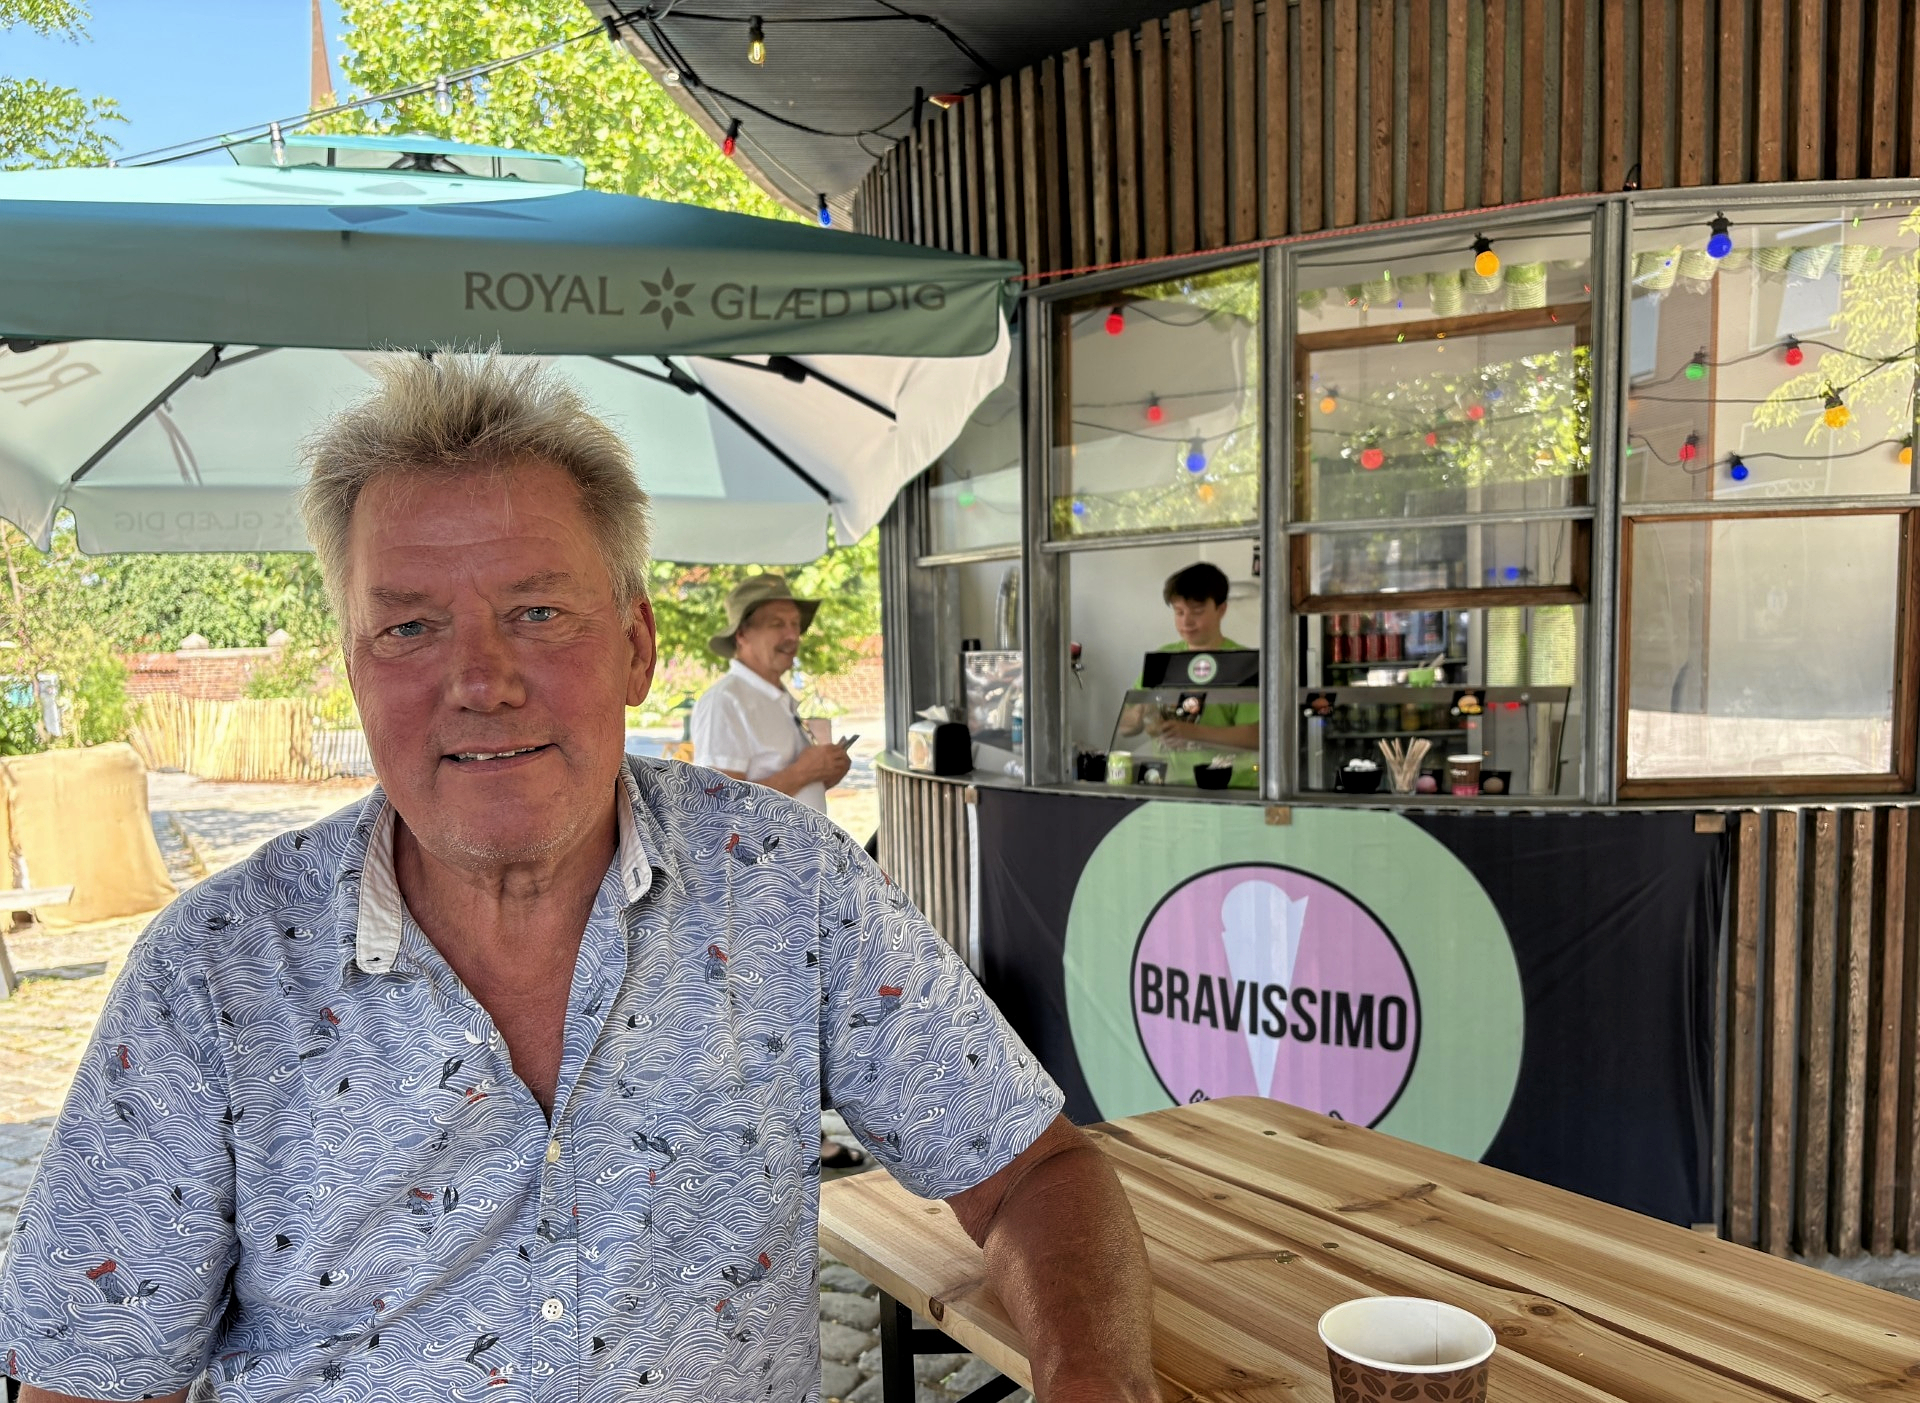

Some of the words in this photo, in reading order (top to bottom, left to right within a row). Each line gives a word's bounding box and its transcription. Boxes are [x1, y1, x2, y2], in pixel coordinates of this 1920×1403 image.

[464, 271, 624, 316] ROYAL
[711, 283, 850, 321] GLÆD
[867, 284, 947, 313] DIG
[1141, 963, 1408, 1052] BRAVISSIMO
